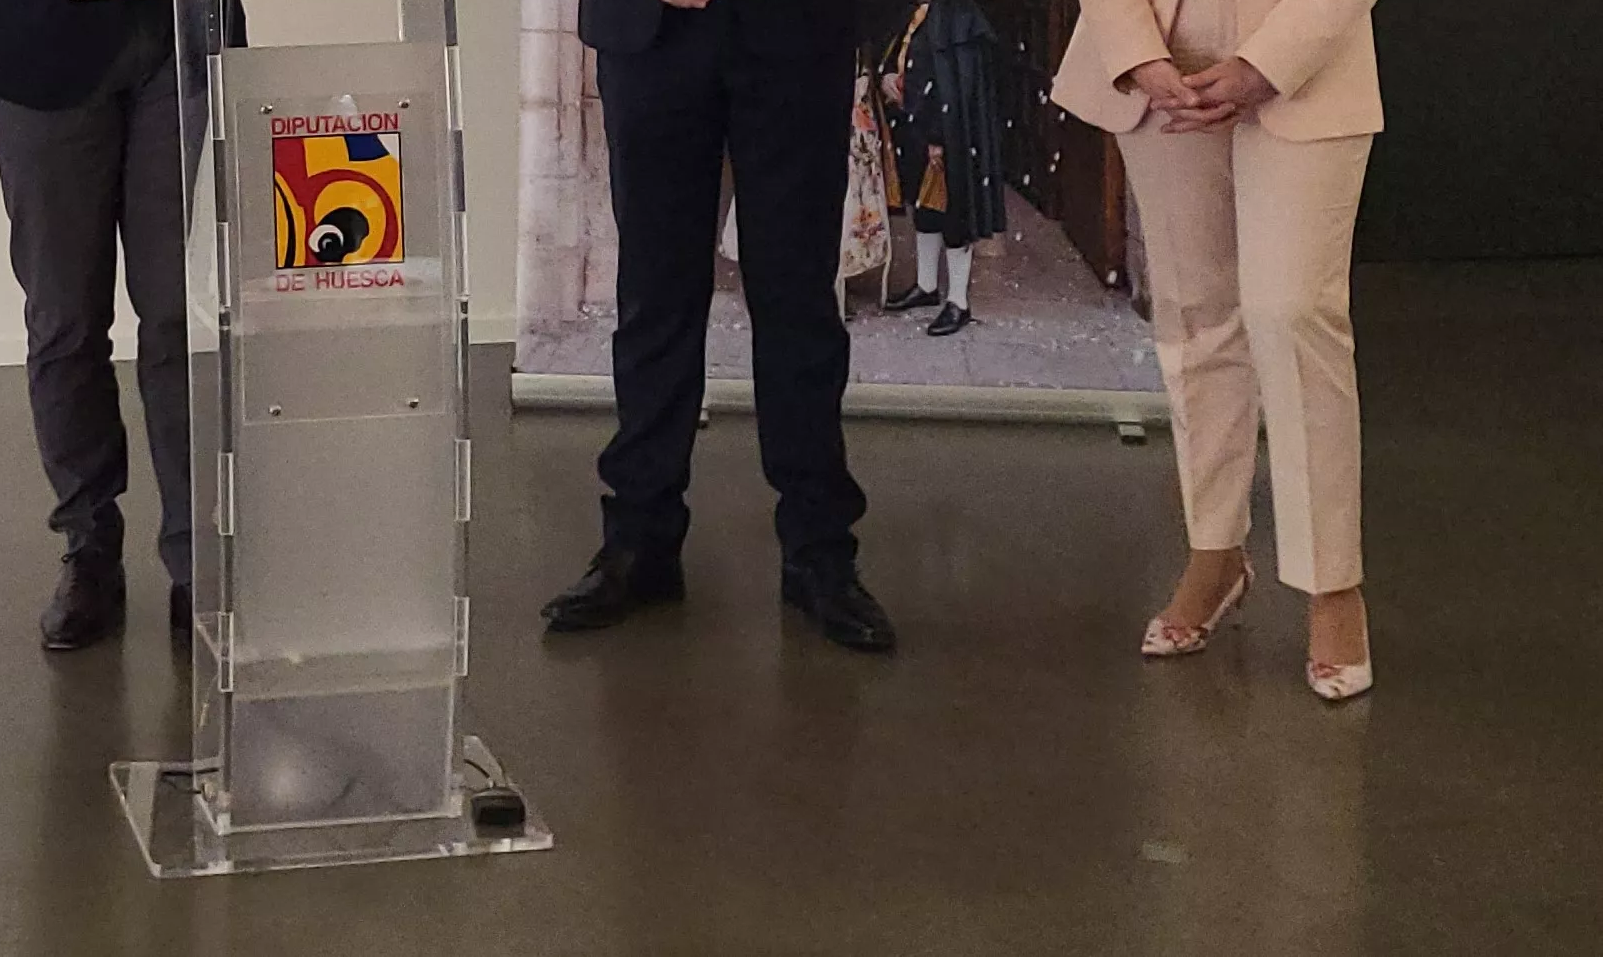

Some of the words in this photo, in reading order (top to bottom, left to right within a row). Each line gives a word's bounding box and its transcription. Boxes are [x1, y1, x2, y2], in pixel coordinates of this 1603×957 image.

[271, 113, 399, 135] DIPUTACION
[276, 272, 306, 292] DE
[315, 269, 405, 290] HUESCA
